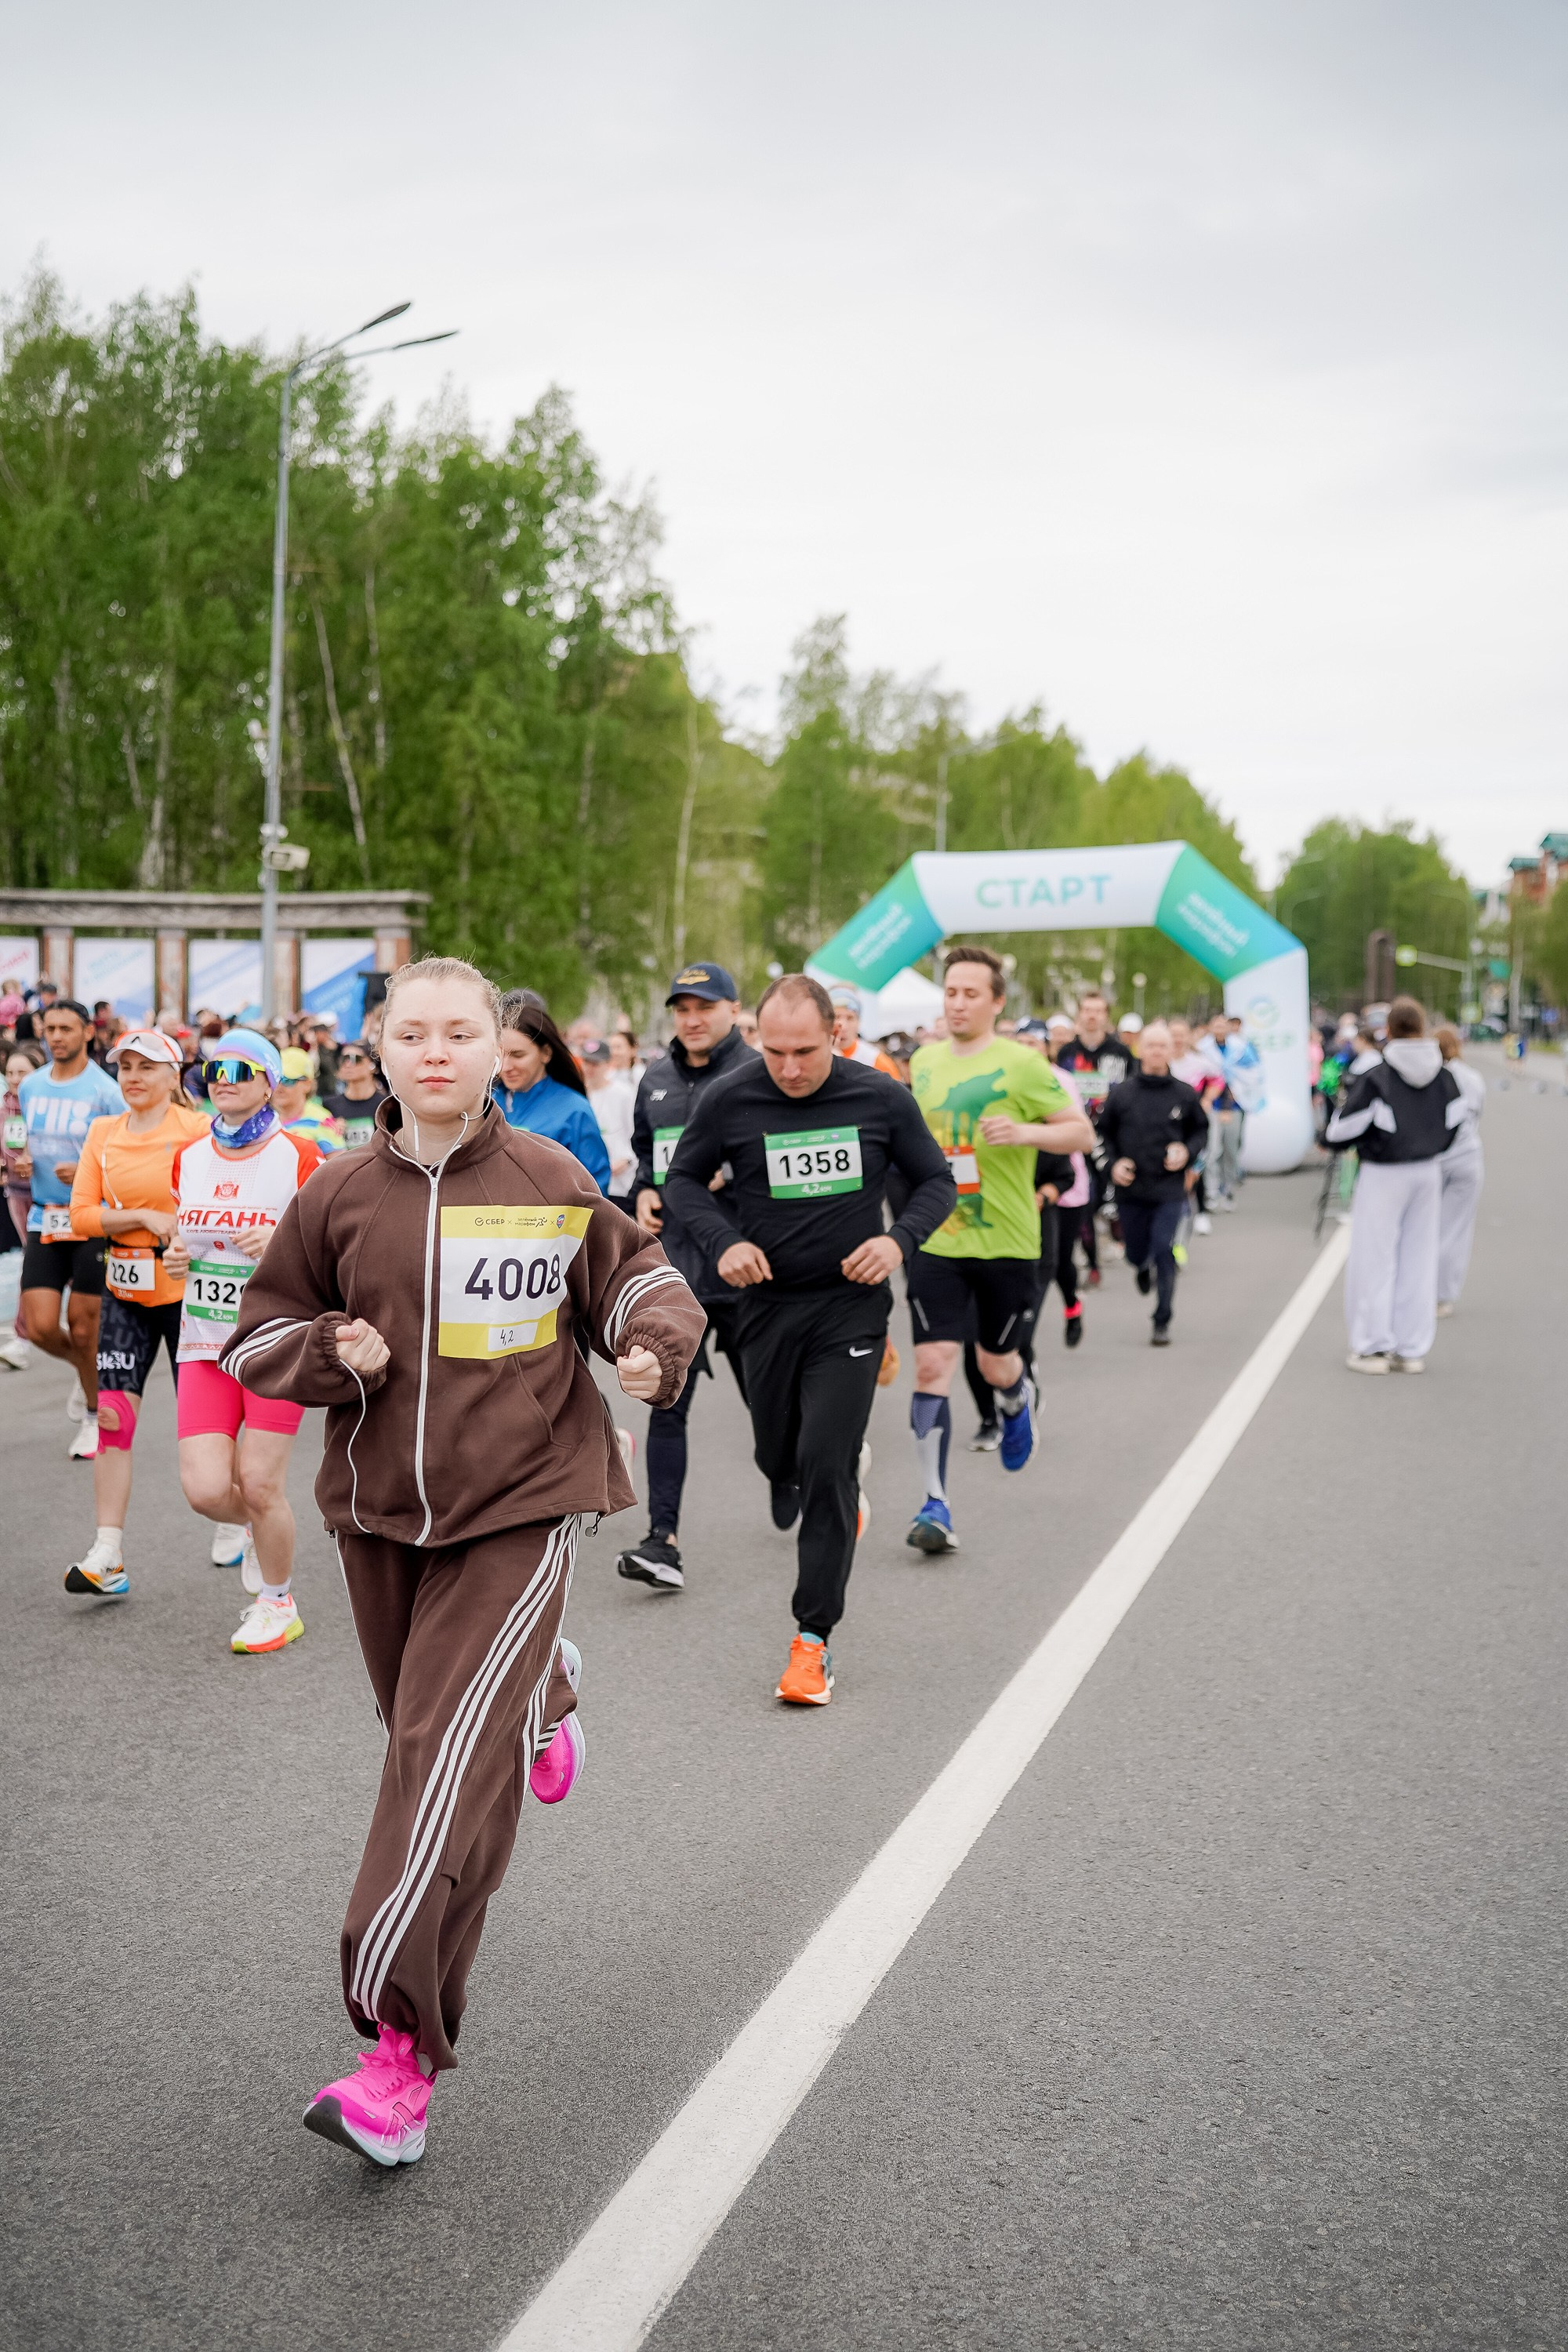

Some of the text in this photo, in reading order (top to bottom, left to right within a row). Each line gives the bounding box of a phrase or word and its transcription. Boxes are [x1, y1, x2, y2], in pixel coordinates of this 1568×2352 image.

[975, 875, 1110, 908] СТАРТ
[780, 1149, 850, 1178] 1358
[180, 1210, 277, 1228] НЯГАНЬ
[465, 1253, 561, 1301] 4008
[500, 1329, 514, 1346] 4,2
